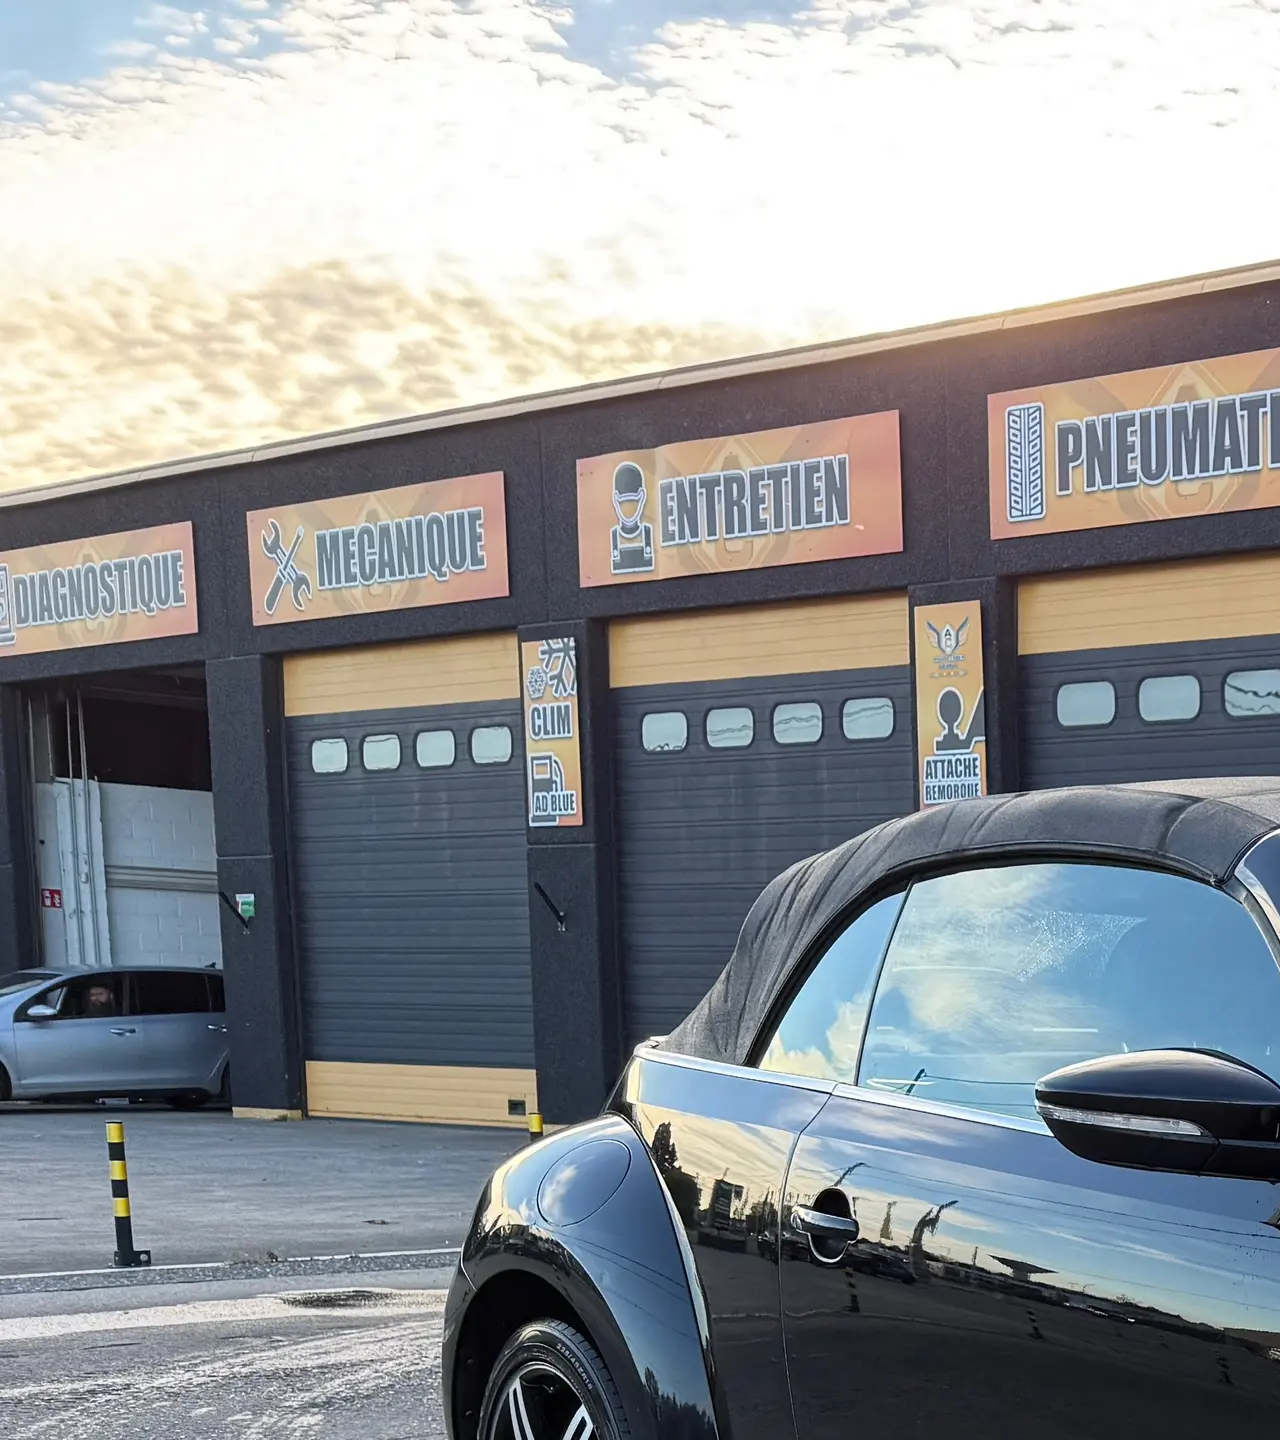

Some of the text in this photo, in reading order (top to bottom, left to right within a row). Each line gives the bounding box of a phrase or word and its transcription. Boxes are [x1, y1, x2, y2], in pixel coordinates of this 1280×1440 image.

[659, 455, 849, 547] ENTRETIEN
[315, 508, 486, 588] MECANIQUE
[12, 551, 186, 627] DIAGNOSTIQUE
[530, 703, 572, 738] CLIM
[925, 757, 980, 780] ATTACHE
[534, 792, 575, 813] AD BLUE
